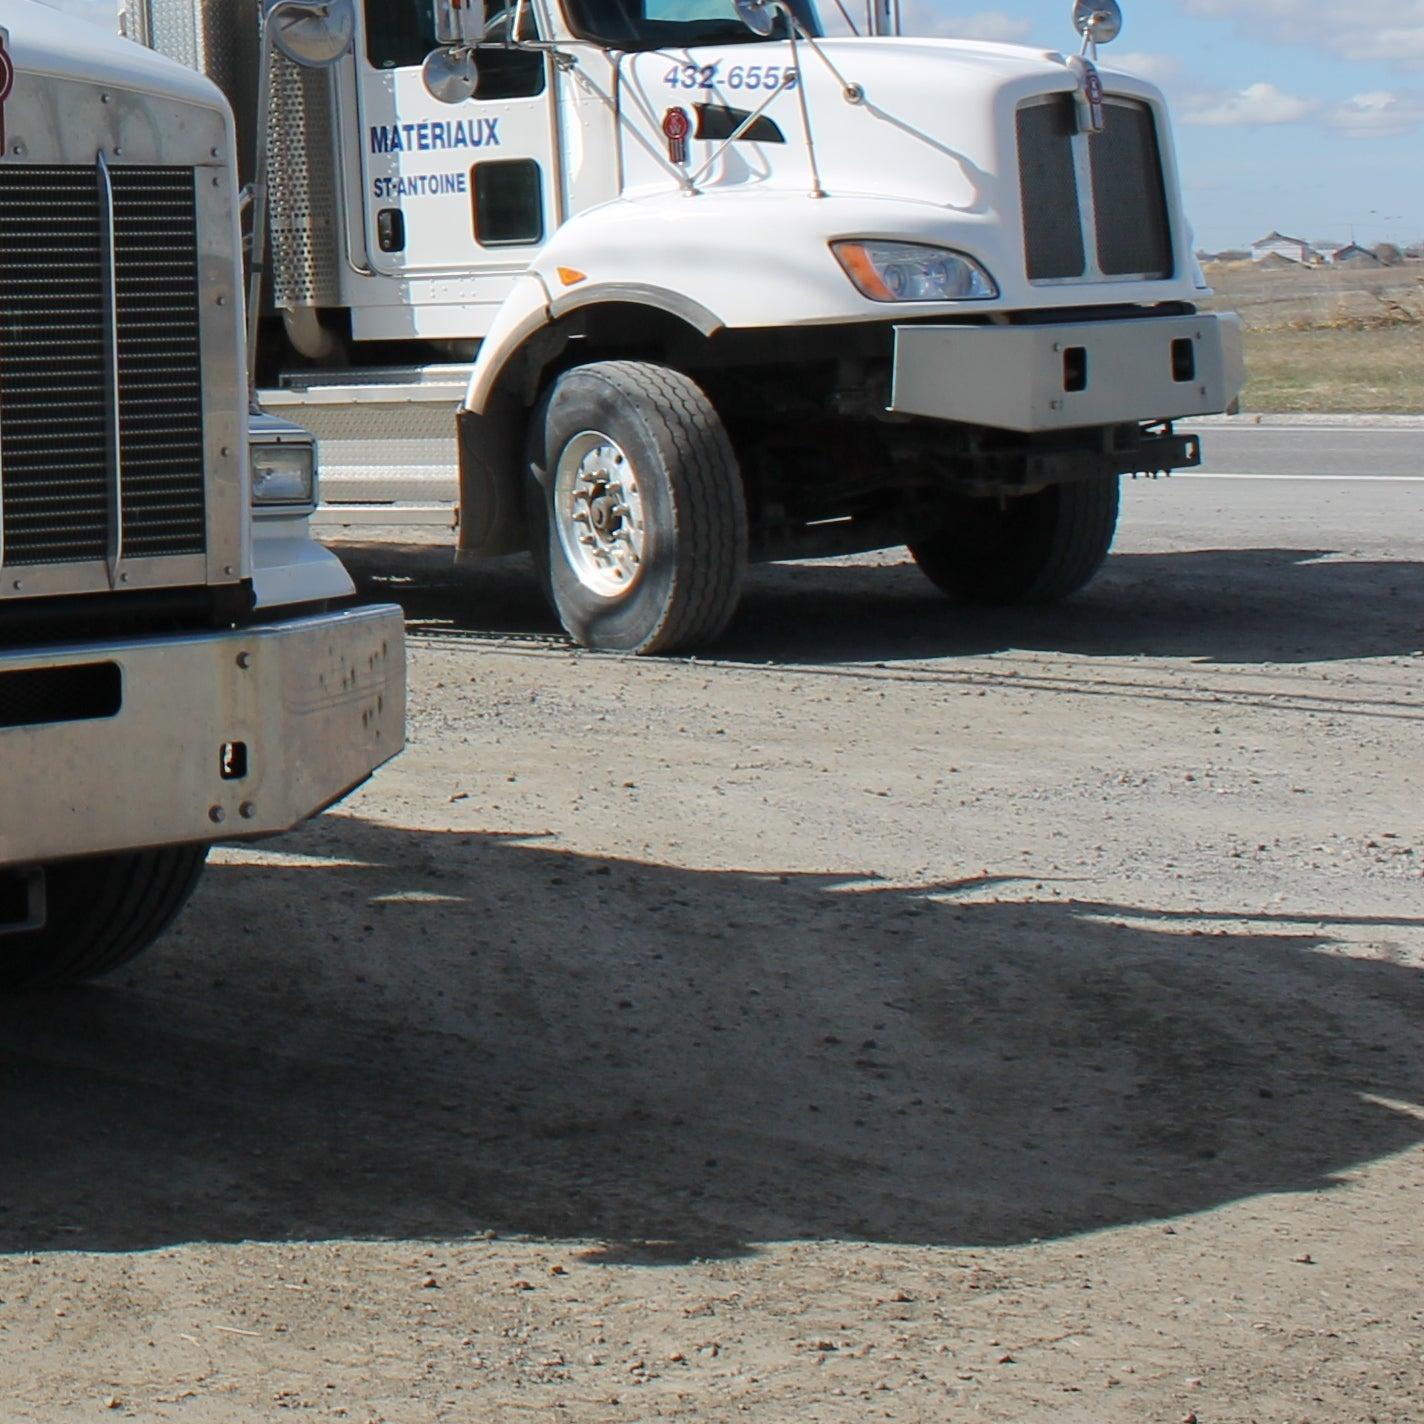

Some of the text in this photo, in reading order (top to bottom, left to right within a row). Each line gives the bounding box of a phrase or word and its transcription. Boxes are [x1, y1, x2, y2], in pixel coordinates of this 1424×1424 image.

[663, 64, 799, 90] 432-6555
[370, 117, 501, 153] MATÉRIAUX
[374, 172, 466, 198] ST-ANTOINE
